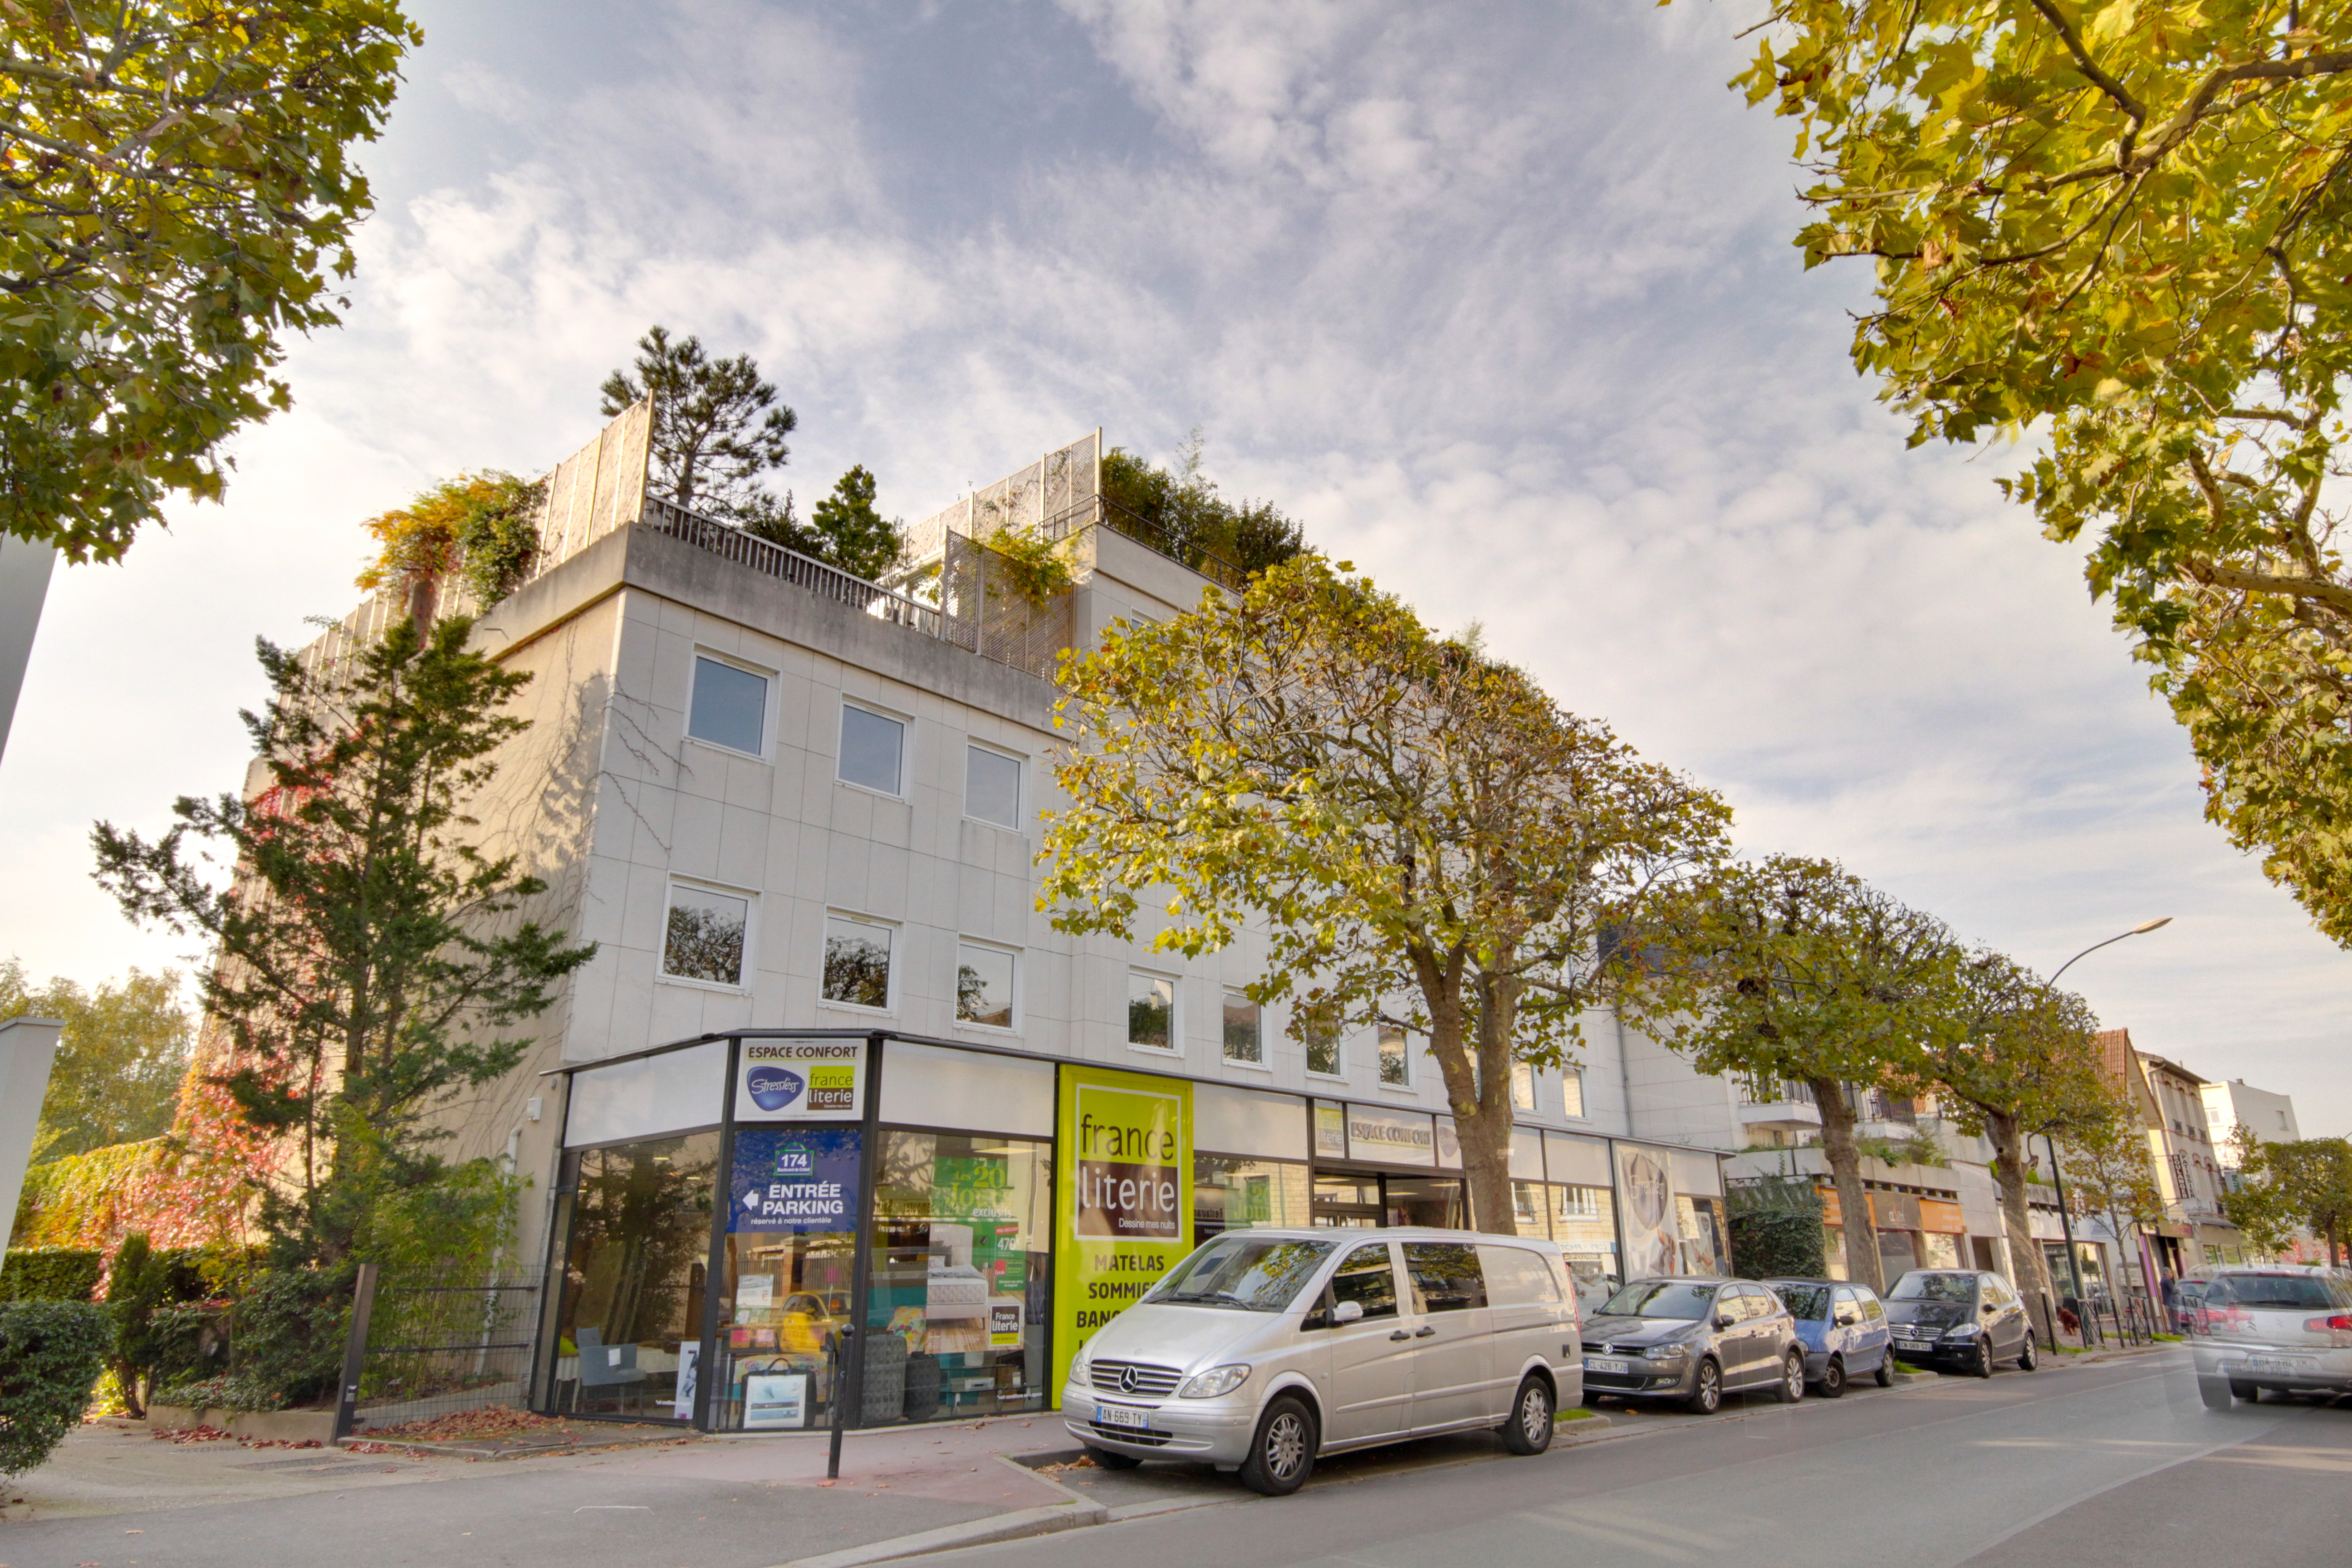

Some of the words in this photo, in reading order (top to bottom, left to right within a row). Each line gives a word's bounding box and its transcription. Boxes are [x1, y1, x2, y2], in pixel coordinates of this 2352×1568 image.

[749, 1047, 792, 1058] ESPACE
[796, 1046, 858, 1058] CONFORT
[751, 1077, 799, 1094] Stressless
[809, 1073, 853, 1086] france
[808, 1089, 852, 1103] literie
[1081, 1113, 1174, 1161] france
[1318, 1129, 1342, 1143] literie
[1350, 1121, 1386, 1141] ESPACE
[1386, 1126, 1432, 1145] CONFORT
[781, 1154, 807, 1167] 174
[956, 1171, 971, 1181] Les
[973, 1166, 1006, 1189] 20
[2173, 1155, 2188, 1199] BOULANGER
[2182, 1155, 2195, 1198] PATISSIER
[769, 1181, 841, 1198] ENTRÉE
[1083, 1166, 1175, 1212] literie
[762, 1200, 843, 1215] PARKING
[973, 1206, 1012, 1218] exclusifs
[1119, 1218, 1144, 1228] Dessine
[1146, 1220, 1159, 1229] mes
[1160, 1220, 1175, 1230] nuits
[1095, 1254, 1164, 1271] MATELAS
[1089, 1282, 1157, 1299] SOMMIE
[995, 1312, 1015, 1320] France
[992, 1320, 1018, 1331] literie
